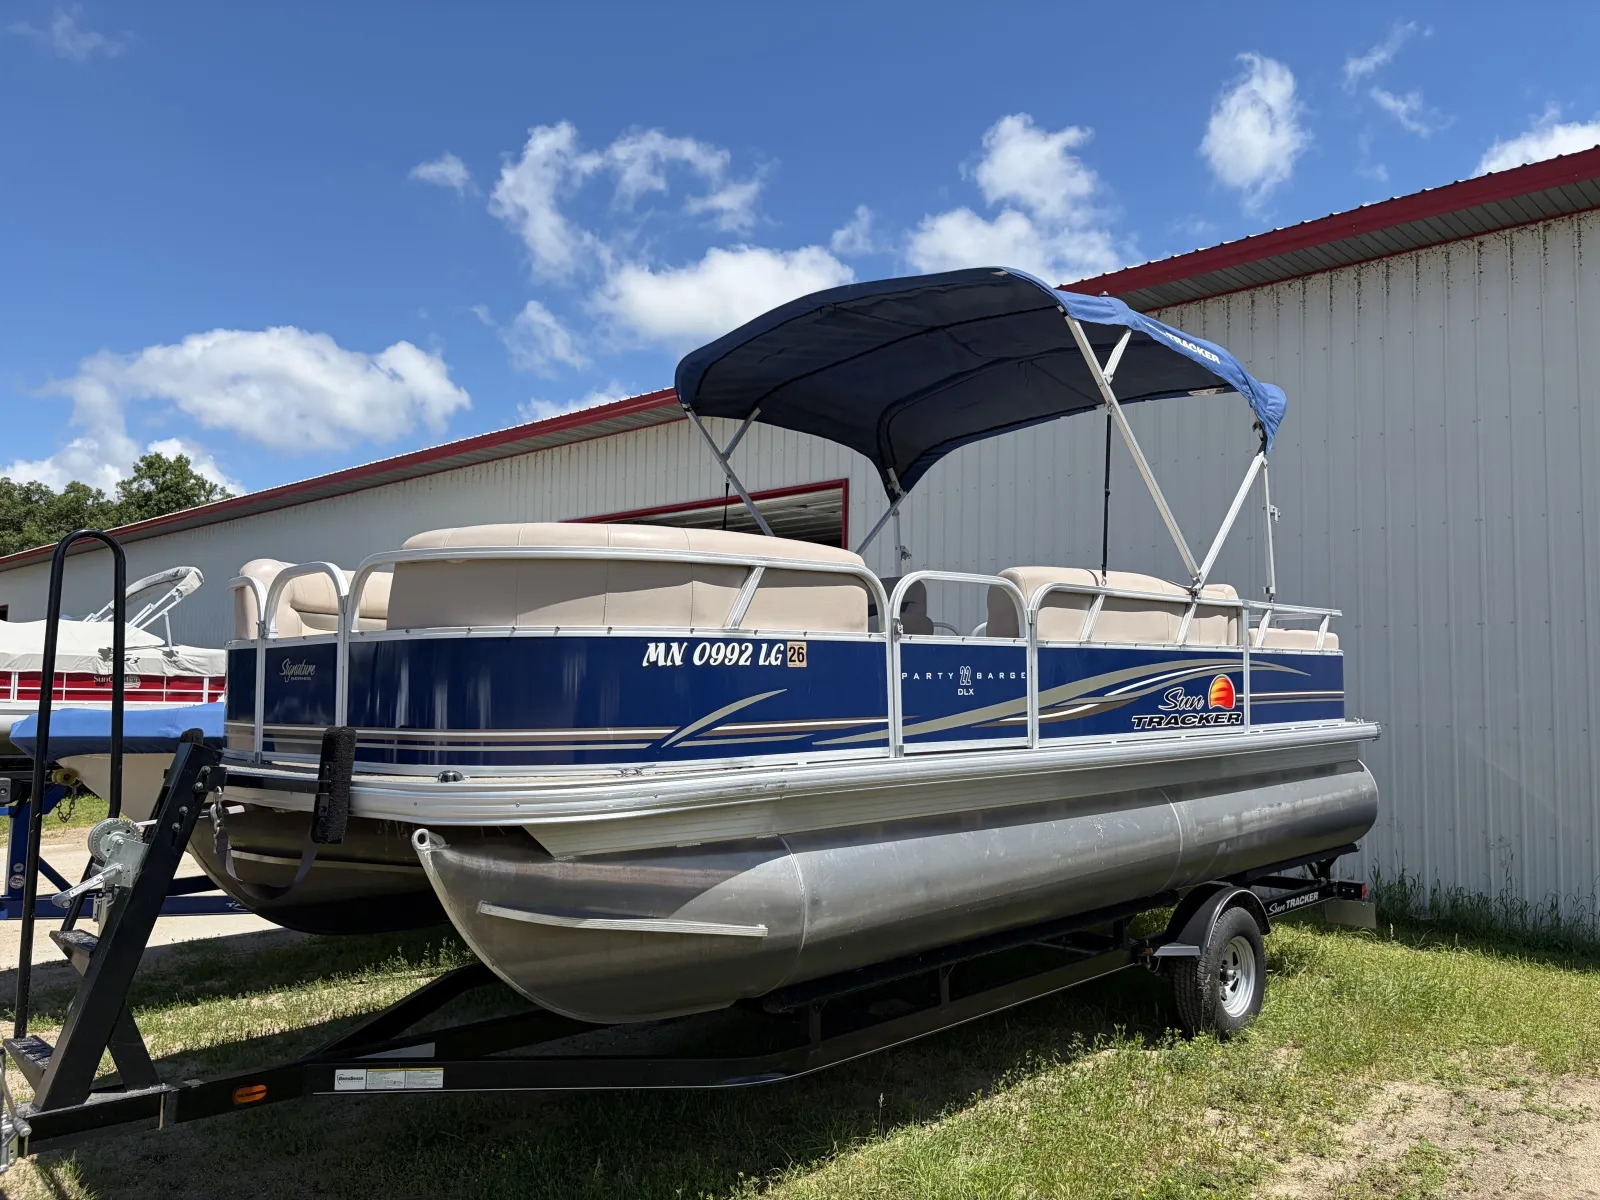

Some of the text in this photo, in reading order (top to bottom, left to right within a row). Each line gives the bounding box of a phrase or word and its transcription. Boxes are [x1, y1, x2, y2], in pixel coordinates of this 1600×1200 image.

[1164, 331, 1221, 365] TRACKER
[642, 641, 784, 667] MN 0992 LG
[788, 646, 805, 663] 26
[279, 658, 316, 683] Signature
[901, 665, 1026, 686] PARTY 22 BARGE
[957, 688, 974, 696] DLX
[1158, 686, 1205, 711] Sun
[1131, 711, 1242, 730] TRACKER
[1267, 891, 1319, 915] Sun TRACKER
